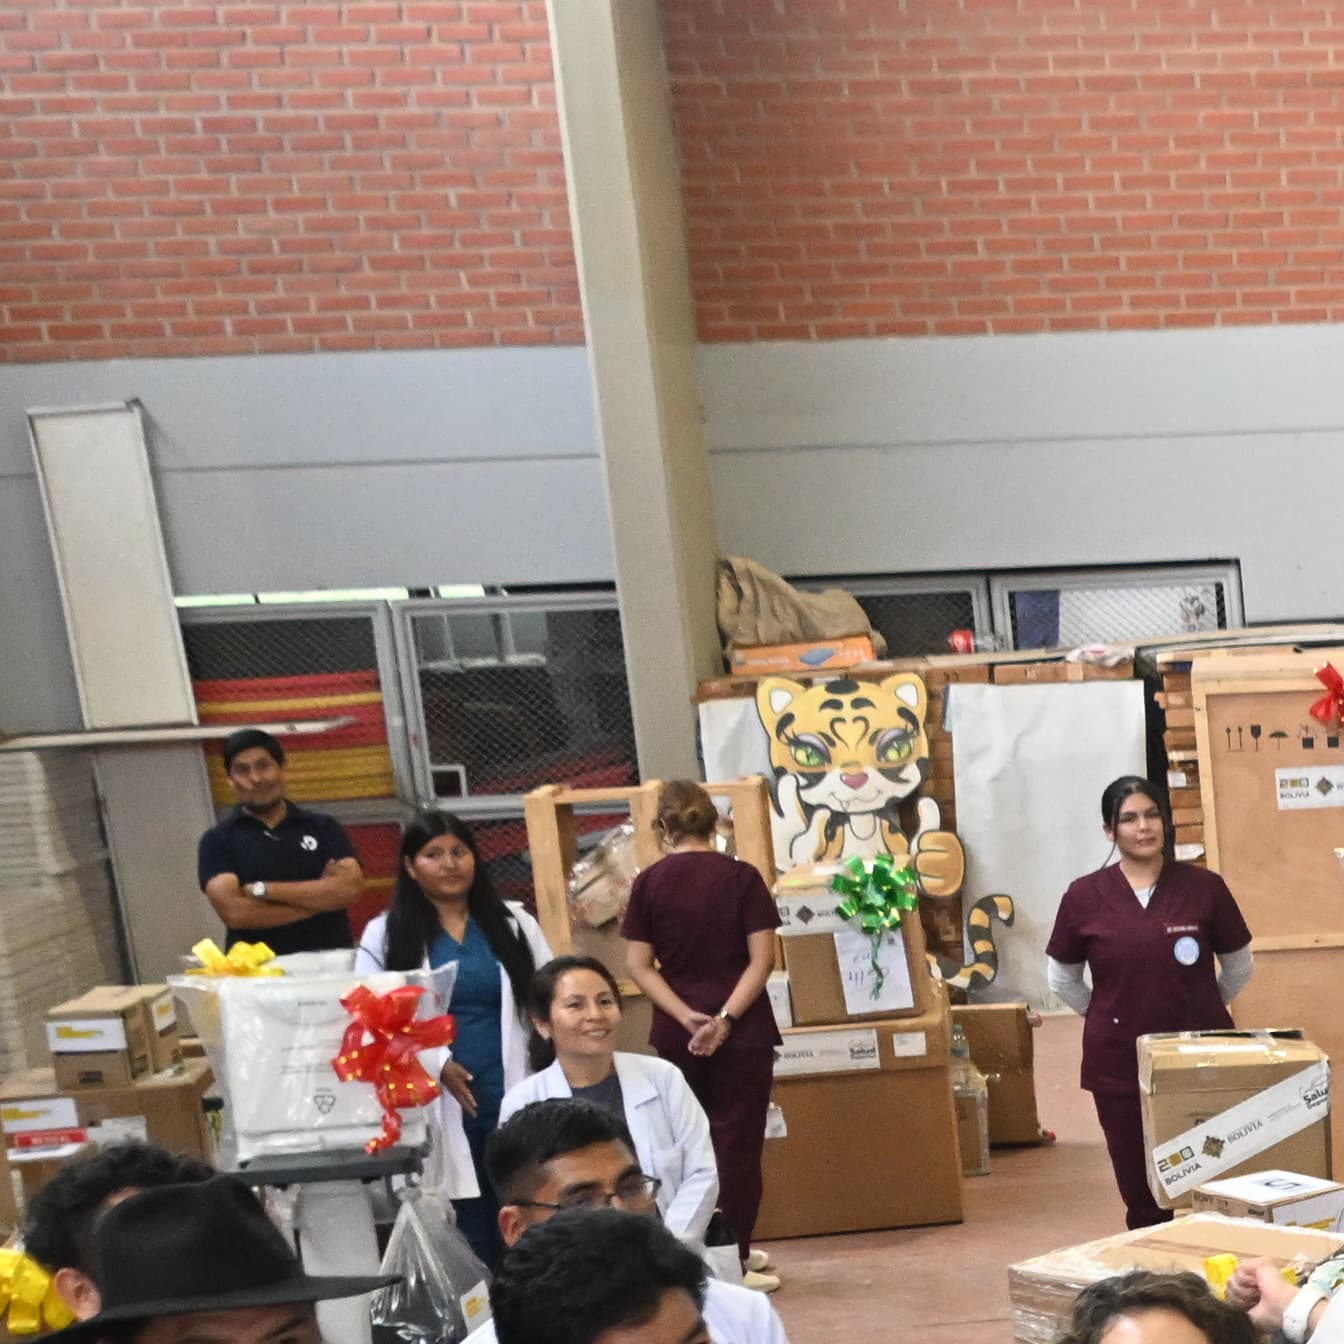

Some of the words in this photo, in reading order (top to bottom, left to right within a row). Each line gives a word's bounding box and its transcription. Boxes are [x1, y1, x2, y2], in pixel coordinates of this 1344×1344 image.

[1303, 1087, 1329, 1105] Salu
[1227, 1118, 1264, 1144] BOLIVIA
[1165, 1163, 1202, 1186] BOLIVIA
